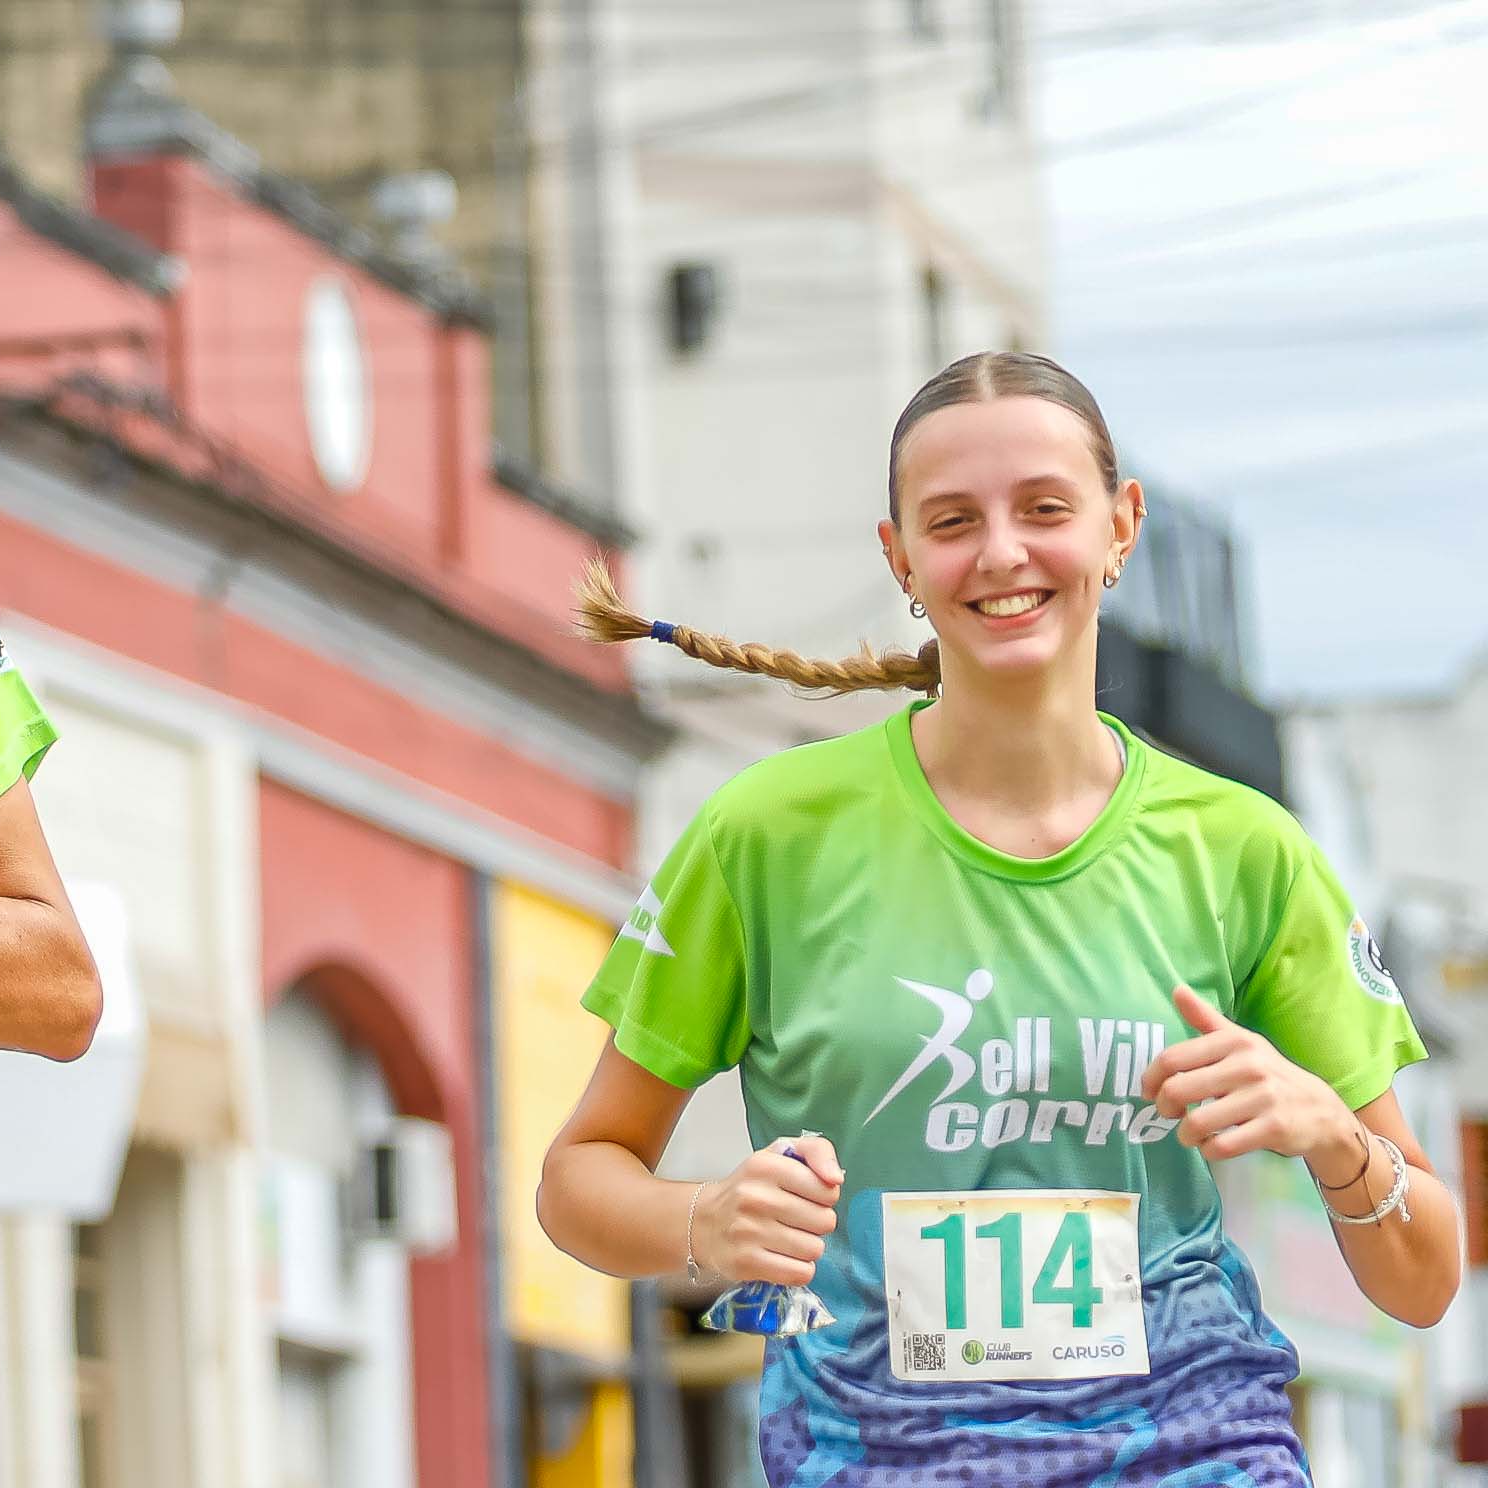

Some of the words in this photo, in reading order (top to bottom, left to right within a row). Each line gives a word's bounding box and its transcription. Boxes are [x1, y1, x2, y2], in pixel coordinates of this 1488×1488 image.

[1078, 1018, 1166, 1096] Vill
[925, 1099, 1182, 1152] corre
[920, 1212, 1104, 1330] 114
[987, 1342, 1011, 1352] CLUB
[1052, 1344, 1125, 1361] CARUSO
